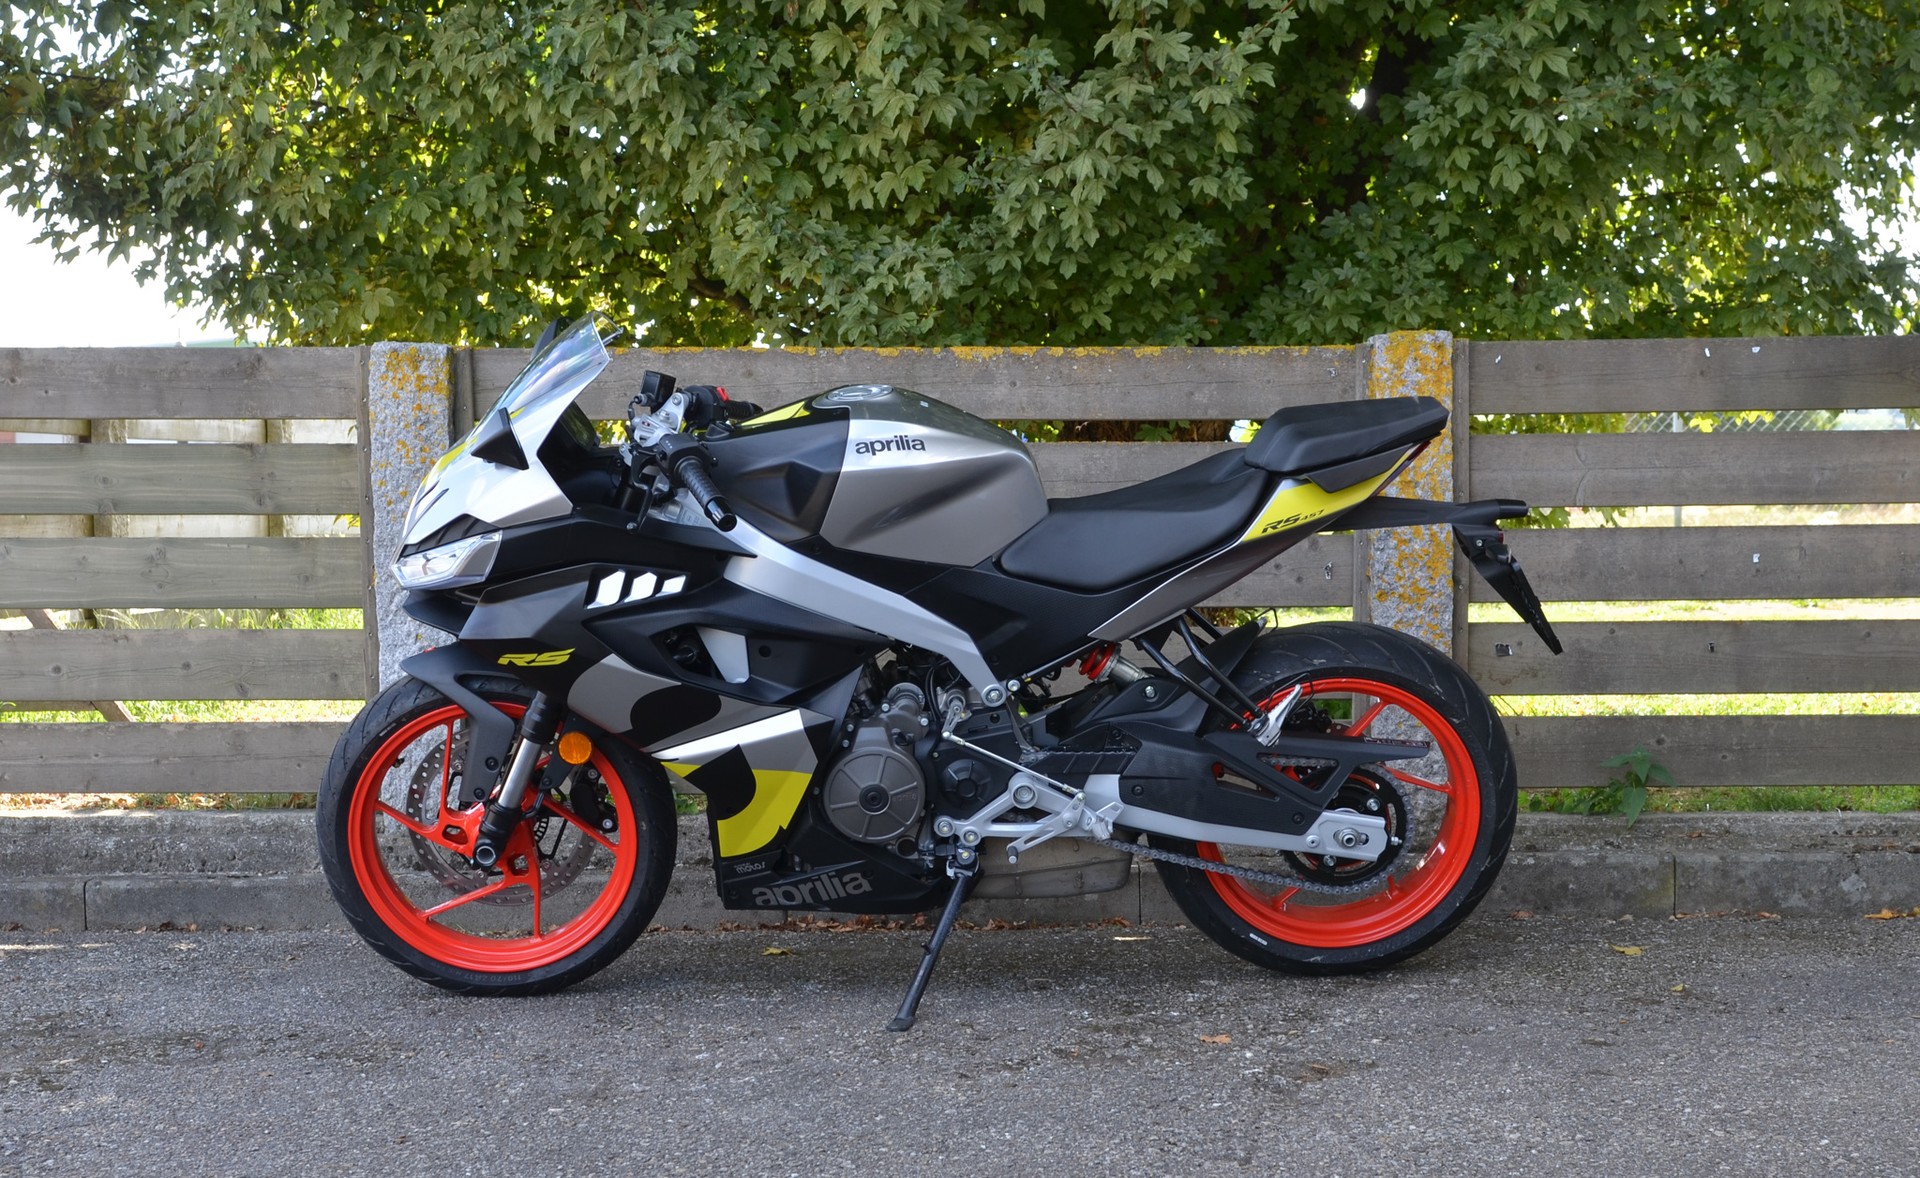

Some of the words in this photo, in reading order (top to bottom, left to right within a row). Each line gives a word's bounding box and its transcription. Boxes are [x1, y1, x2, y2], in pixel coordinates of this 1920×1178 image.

[855, 434, 926, 456] aprilia
[1261, 512, 1302, 534] RS
[1301, 508, 1325, 522] 457
[497, 648, 576, 667] RS
[751, 871, 873, 907] aprilia
